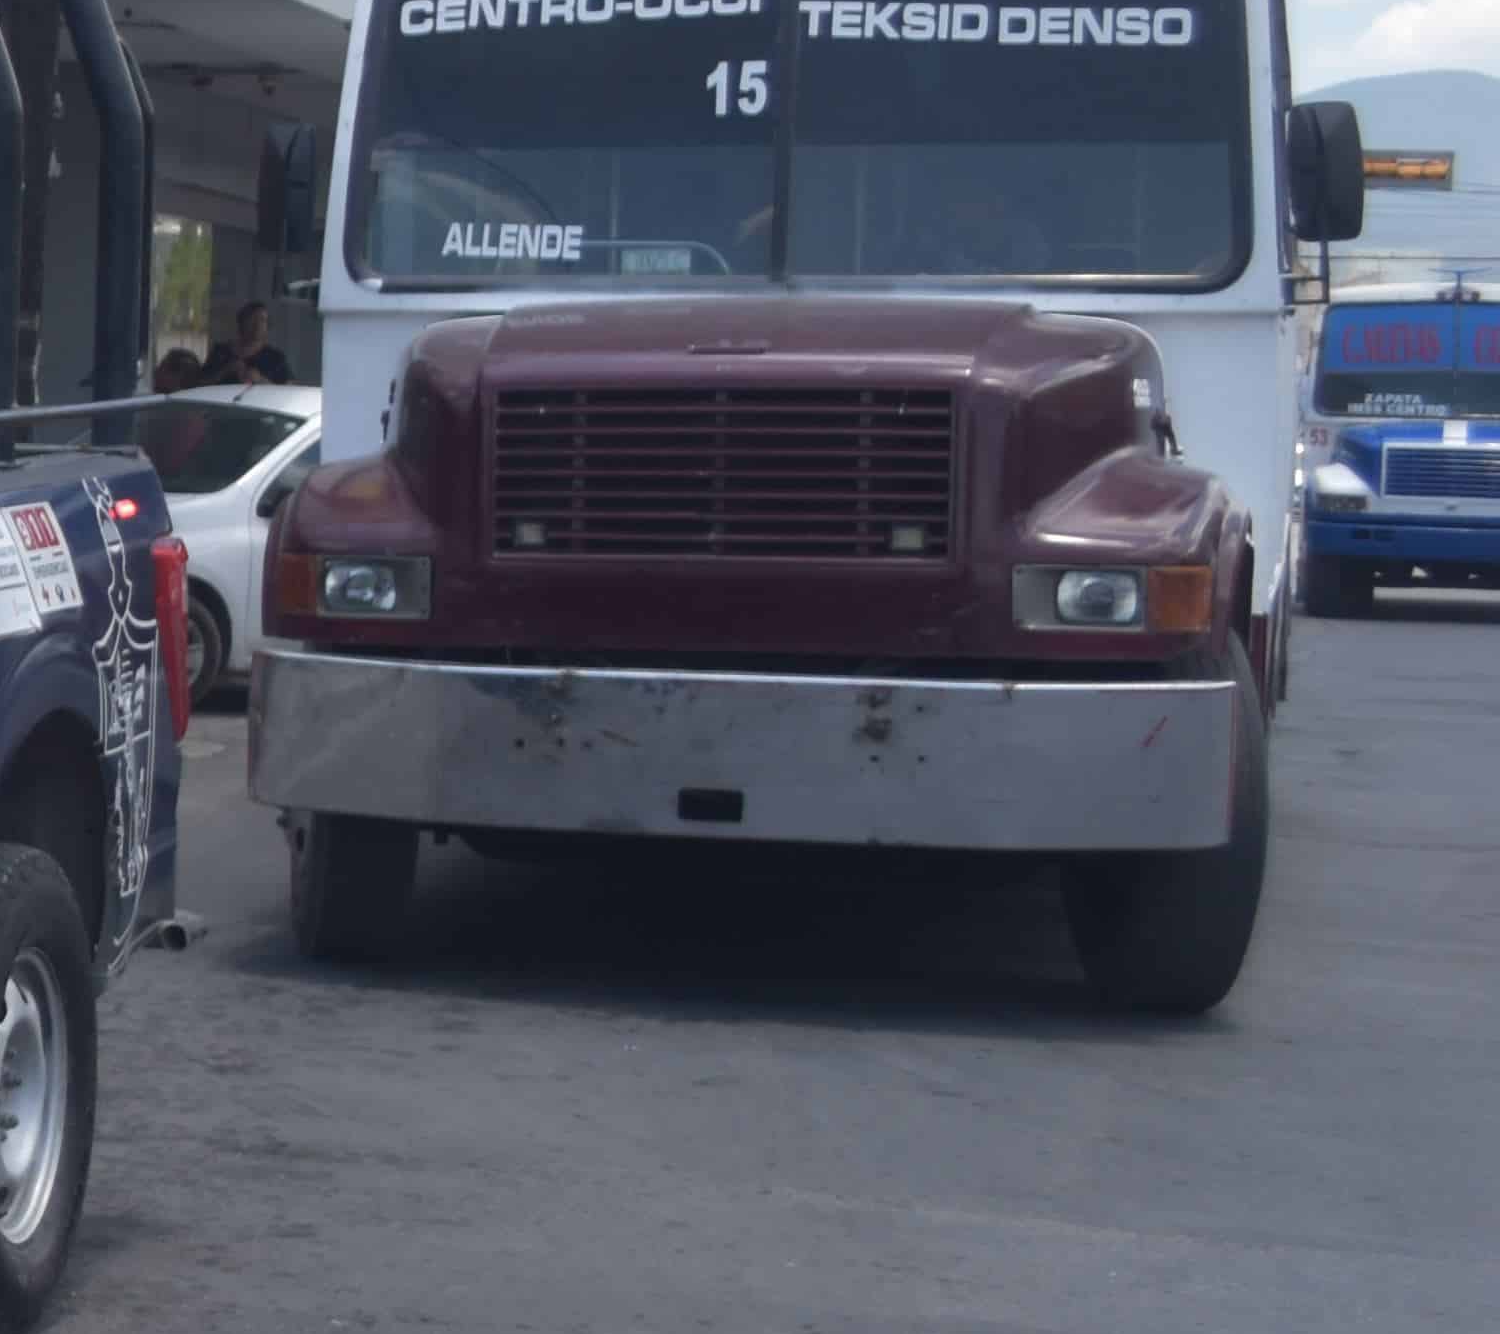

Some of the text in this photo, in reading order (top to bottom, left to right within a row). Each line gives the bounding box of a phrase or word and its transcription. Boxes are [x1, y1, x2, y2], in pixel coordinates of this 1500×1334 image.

[799, 0, 1194, 47] TEKSID DENSO
[705, 60, 768, 118] 15
[441, 222, 583, 260] ALLENDE
[1364, 393, 1423, 404] ZAPATA
